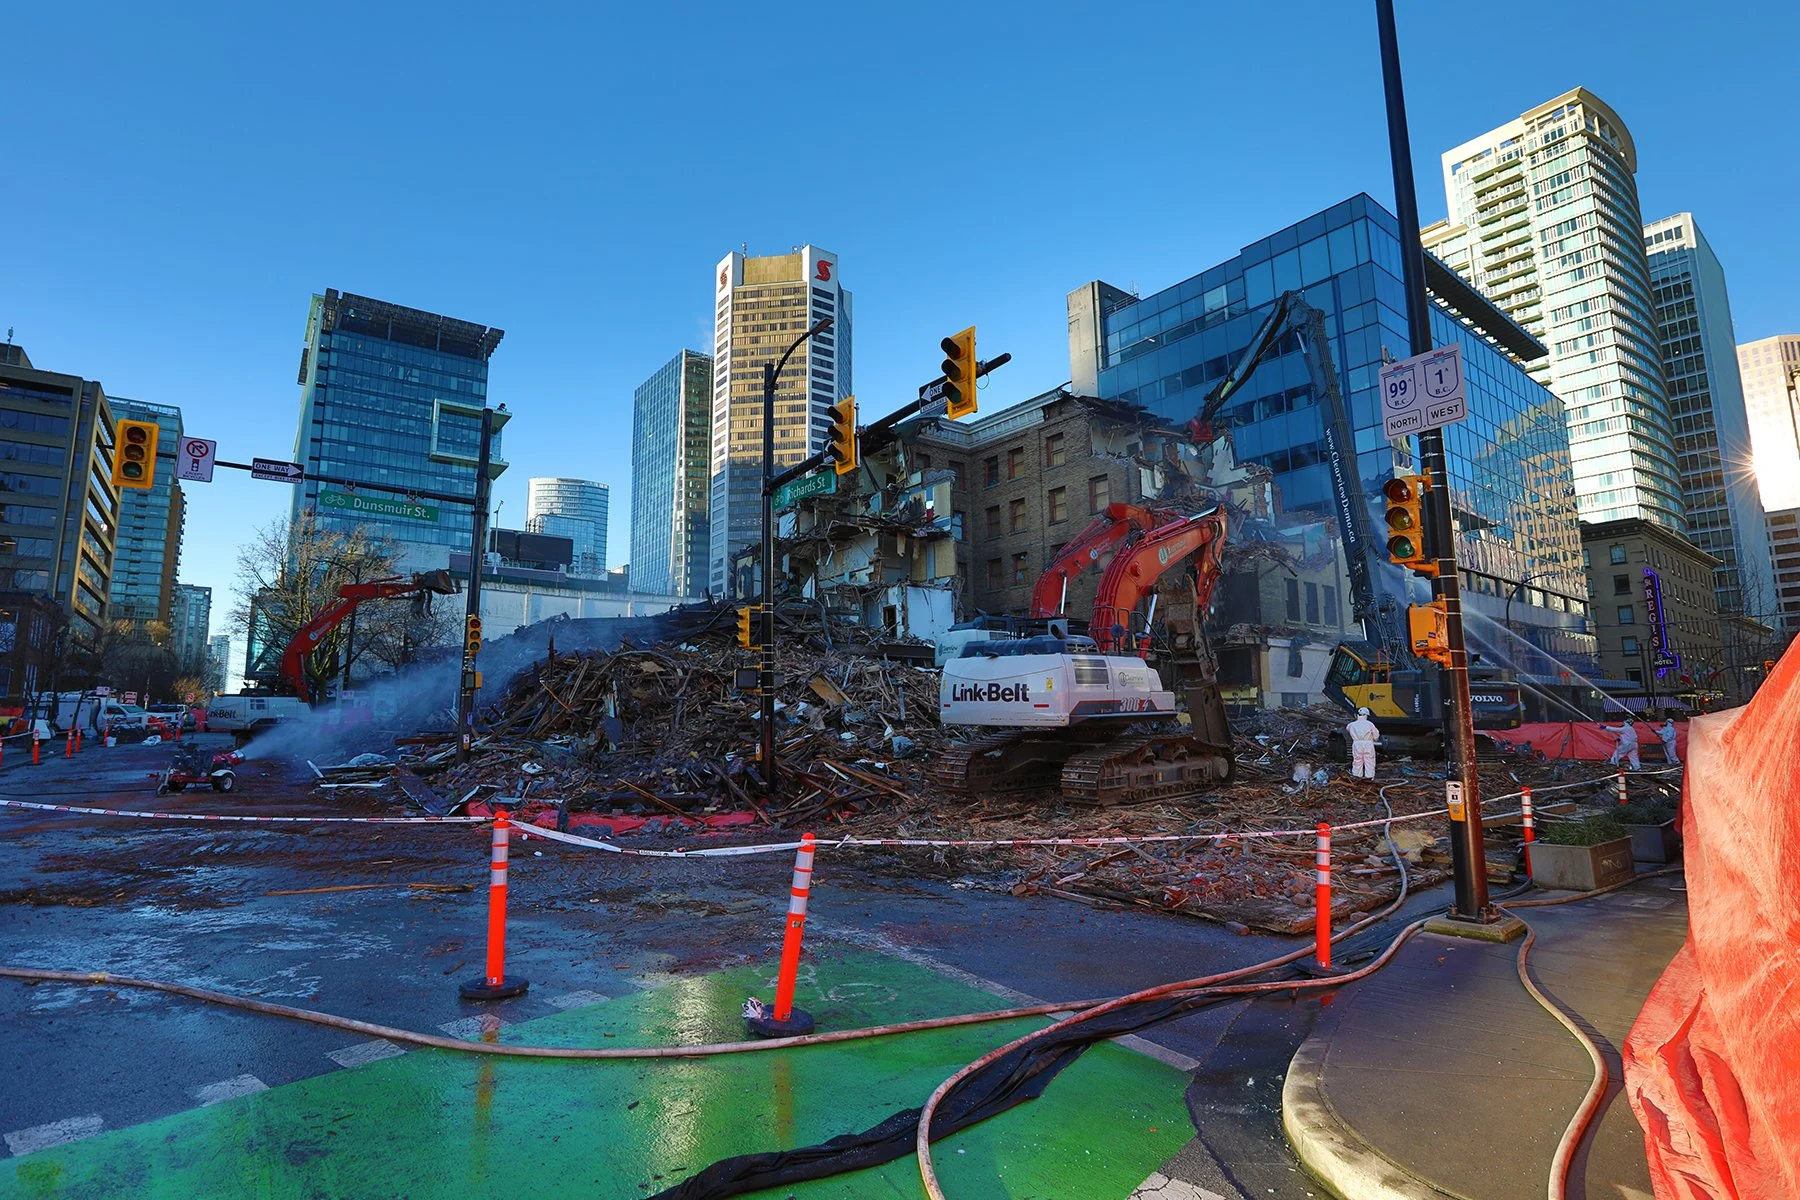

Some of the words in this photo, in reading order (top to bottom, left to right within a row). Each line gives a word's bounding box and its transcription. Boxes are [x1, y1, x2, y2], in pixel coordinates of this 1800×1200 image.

[1435, 386, 1451, 395] B.C.
[1394, 398, 1410, 407] B.C.
[1430, 404, 1460, 419] WEST
[1390, 415, 1418, 430] NORTH
[255, 463, 272, 471] ONE
[273, 465, 290, 473] WAY
[817, 476, 826, 489] St
[1325, 427, 1356, 544] www.ClearviewDemo.ca
[353, 498, 413, 516] Dunsmuir
[414, 506, 430, 519] St.
[952, 683, 1030, 703] Link-Belt
[1470, 694, 1503, 702] VOLVO
